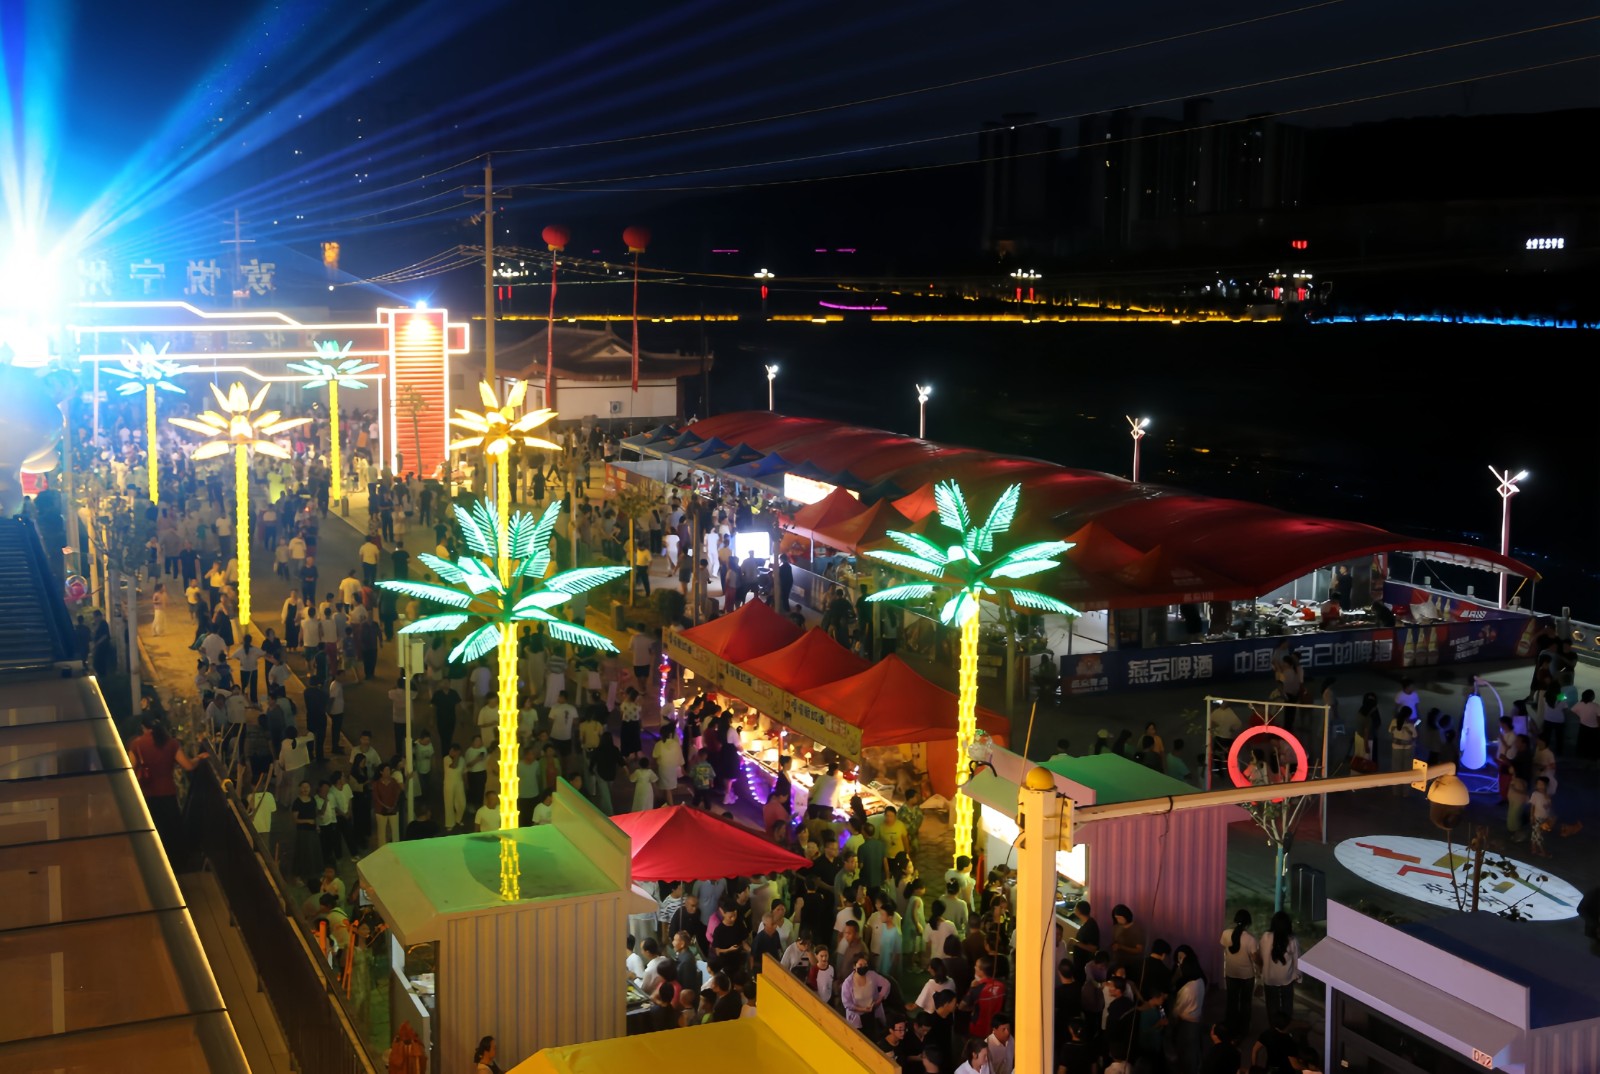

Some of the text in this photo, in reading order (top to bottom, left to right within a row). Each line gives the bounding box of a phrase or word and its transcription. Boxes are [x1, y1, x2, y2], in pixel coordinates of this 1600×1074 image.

[1127, 654, 1214, 685] 燕京啤酒
[1233, 638, 1393, 674] 中国自己的啤酒
